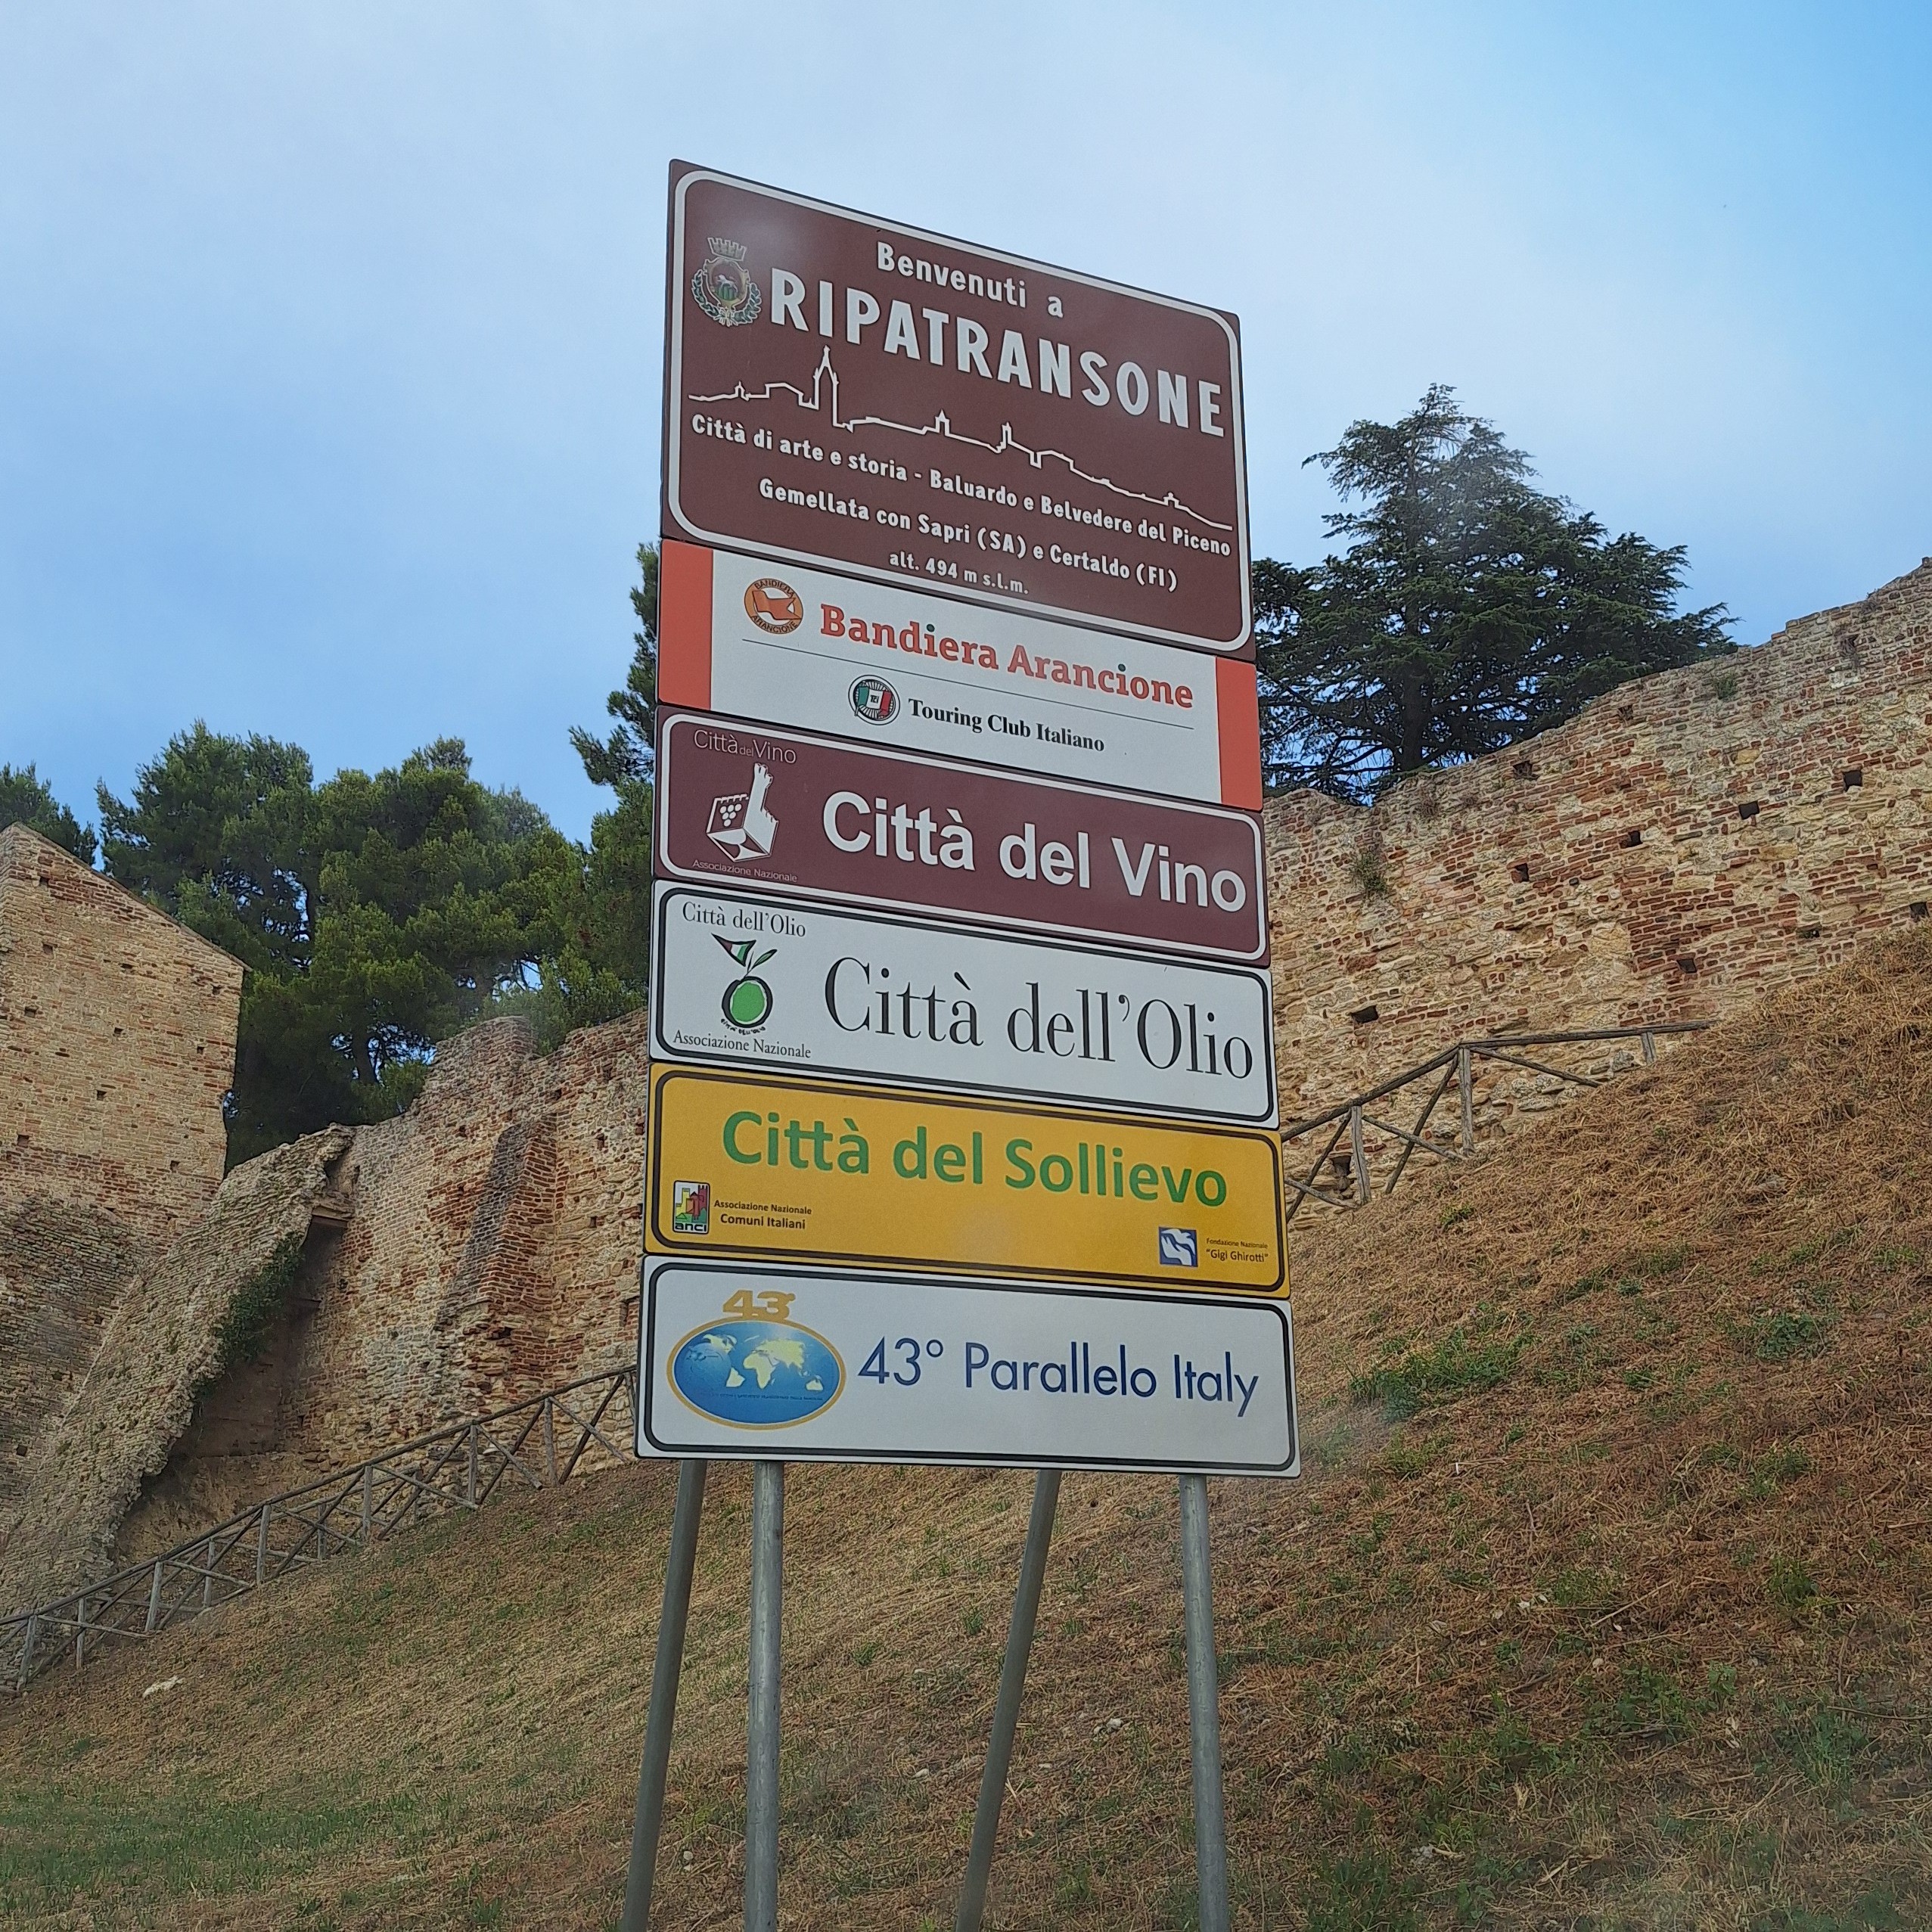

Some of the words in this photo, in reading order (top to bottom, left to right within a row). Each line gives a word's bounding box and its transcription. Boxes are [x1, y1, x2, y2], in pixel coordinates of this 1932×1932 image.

[877, 241, 1026, 309] Benvenuti
[1048, 295, 1064, 318] a
[771, 267, 1224, 438] RIPATRANSONE
[691, 414, 747, 444] Città
[753, 428, 773, 450] di
[780, 437, 824, 462] arte
[831, 449, 842, 466] e
[848, 452, 908, 482] storia
[930, 468, 1017, 508] Baluardo
[1023, 493, 1035, 511] e
[1041, 495, 1132, 534] Belvedere
[1138, 518, 1166, 543] del
[1173, 525, 1232, 557] Piceno
[759, 477, 870, 521] Gemellata
[876, 508, 912, 530] con
[918, 514, 971, 545] Sapri
[977, 526, 1027, 560] (SA)
[1033, 543, 1044, 561] e
[1049, 543, 1131, 579] Certaldo
[1136, 562, 1178, 592] (FI)
[889, 550, 920, 571] alt.
[925, 557, 958, 579] 494
[964, 567, 978, 584] m
[982, 572, 1030, 595] s.l.m.
[820, 602, 999, 670] Bandiera
[1007, 644, 1194, 709] Arancione
[693, 729, 738, 755] Città
[739, 745, 753, 757] del
[753, 739, 797, 764] Vino
[908, 697, 983, 735] Touring
[987, 713, 1031, 738] Club
[1036, 722, 1105, 753] Italiano
[692, 859, 751, 876] Associazione
[753, 868, 798, 883] Nazionale
[822, 791, 976, 871] Città
[999, 822, 1091, 889] del
[1110, 836, 1247, 913] Vino
[682, 901, 726, 927] Città
[732, 909, 806, 937] dell'Olio
[672, 1029, 750, 1051] Associazione
[753, 1038, 812, 1059] Nazionale
[825, 956, 984, 1047] Città
[1007, 982, 1253, 1079] dell'Olio
[722, 1110, 870, 1175] Città
[893, 1126, 983, 1185] del
[1005, 1138, 1228, 1208] Sollievo
[675, 1222, 707, 1232] anci
[713, 1199, 769, 1212] Associazione
[771, 1204, 812, 1215] Nazionale
[720, 1213, 764, 1226] Comuni
[767, 1216, 806, 1230] Italiani
[1206, 1248, 1228, 1262] "Gigi
[1230, 1250, 1269, 1263] Ghirotti"
[857, 1336, 944, 1387] 43°
[965, 1340, 1157, 1398] Parallelo
[1174, 1351, 1260, 1418] Italy
